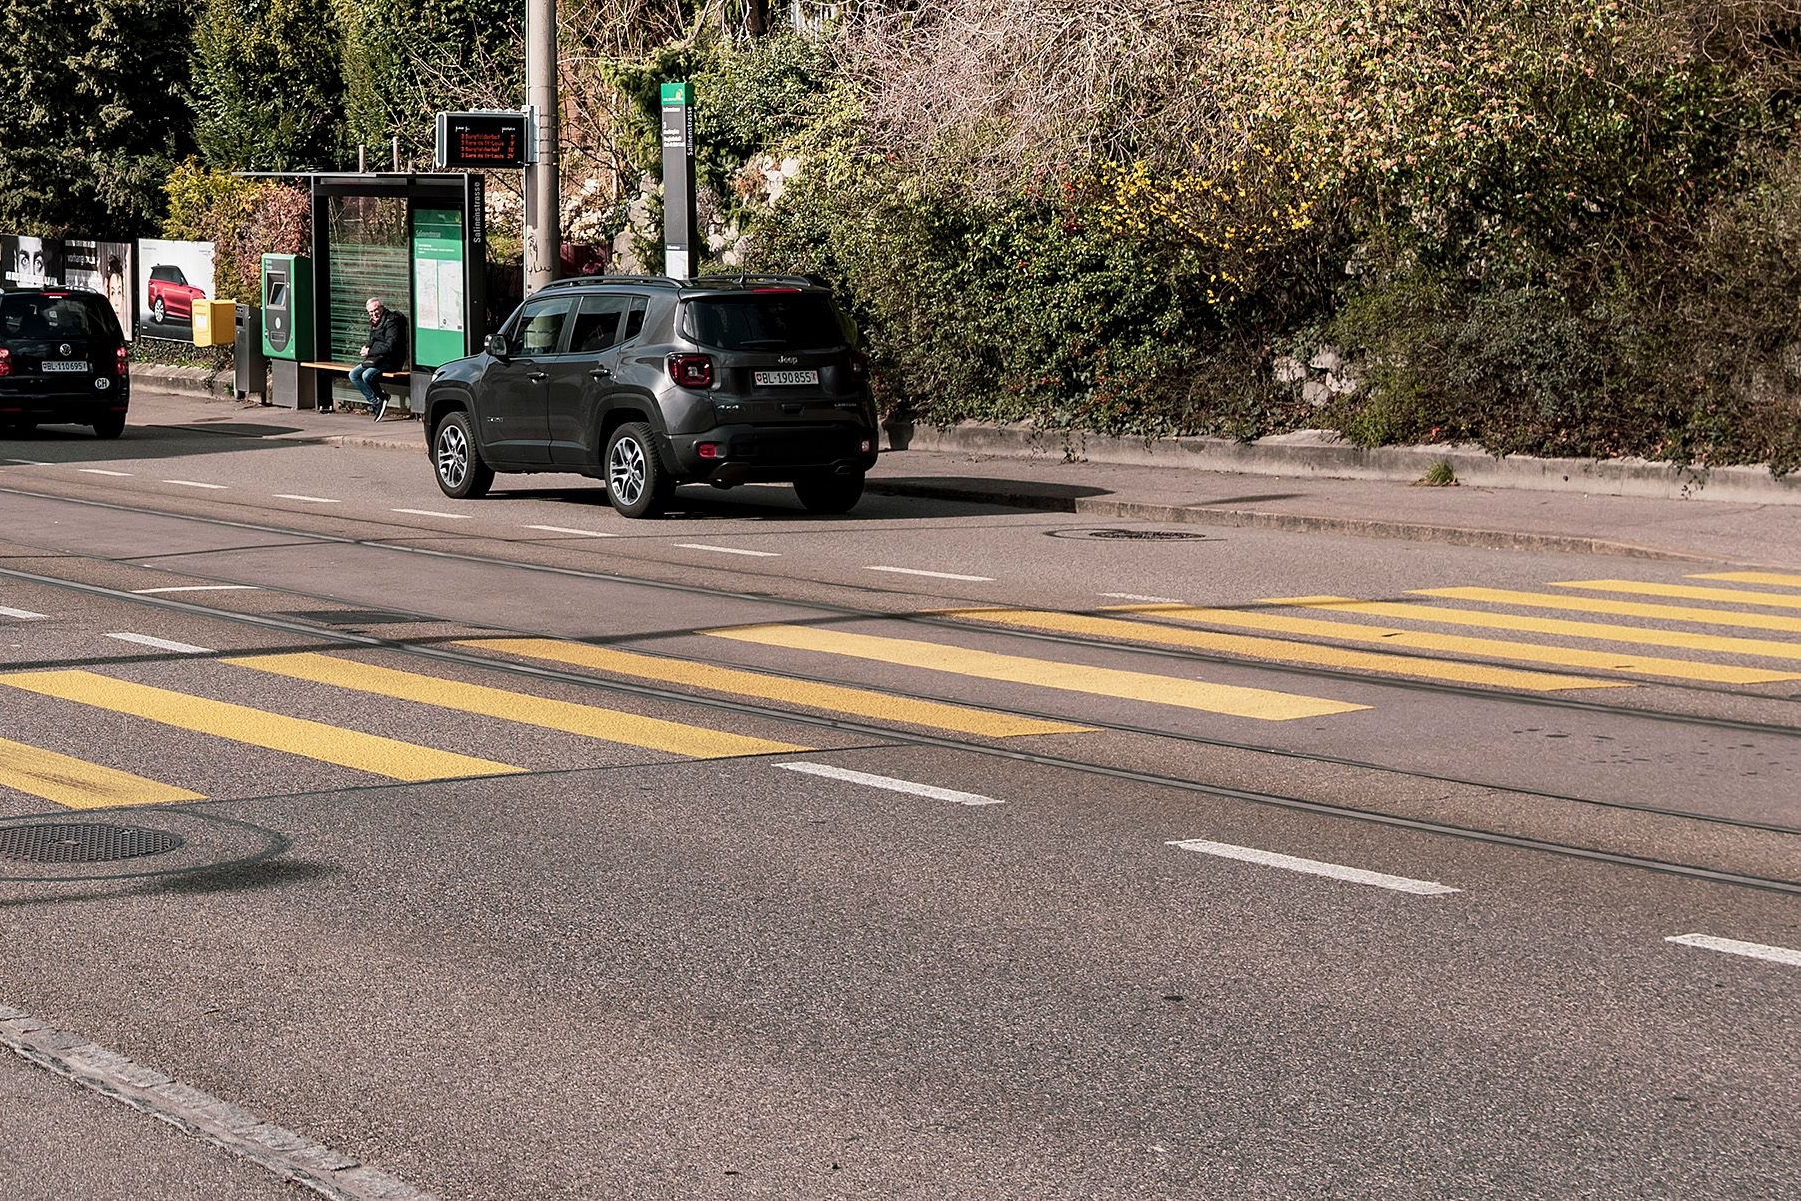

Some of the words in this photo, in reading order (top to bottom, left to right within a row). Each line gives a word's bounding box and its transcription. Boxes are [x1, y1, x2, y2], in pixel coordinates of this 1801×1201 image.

[473, 181, 481, 243] Salinenstrasse
[778, 355, 798, 365] Jeep
[96, 379, 108, 388] CH
